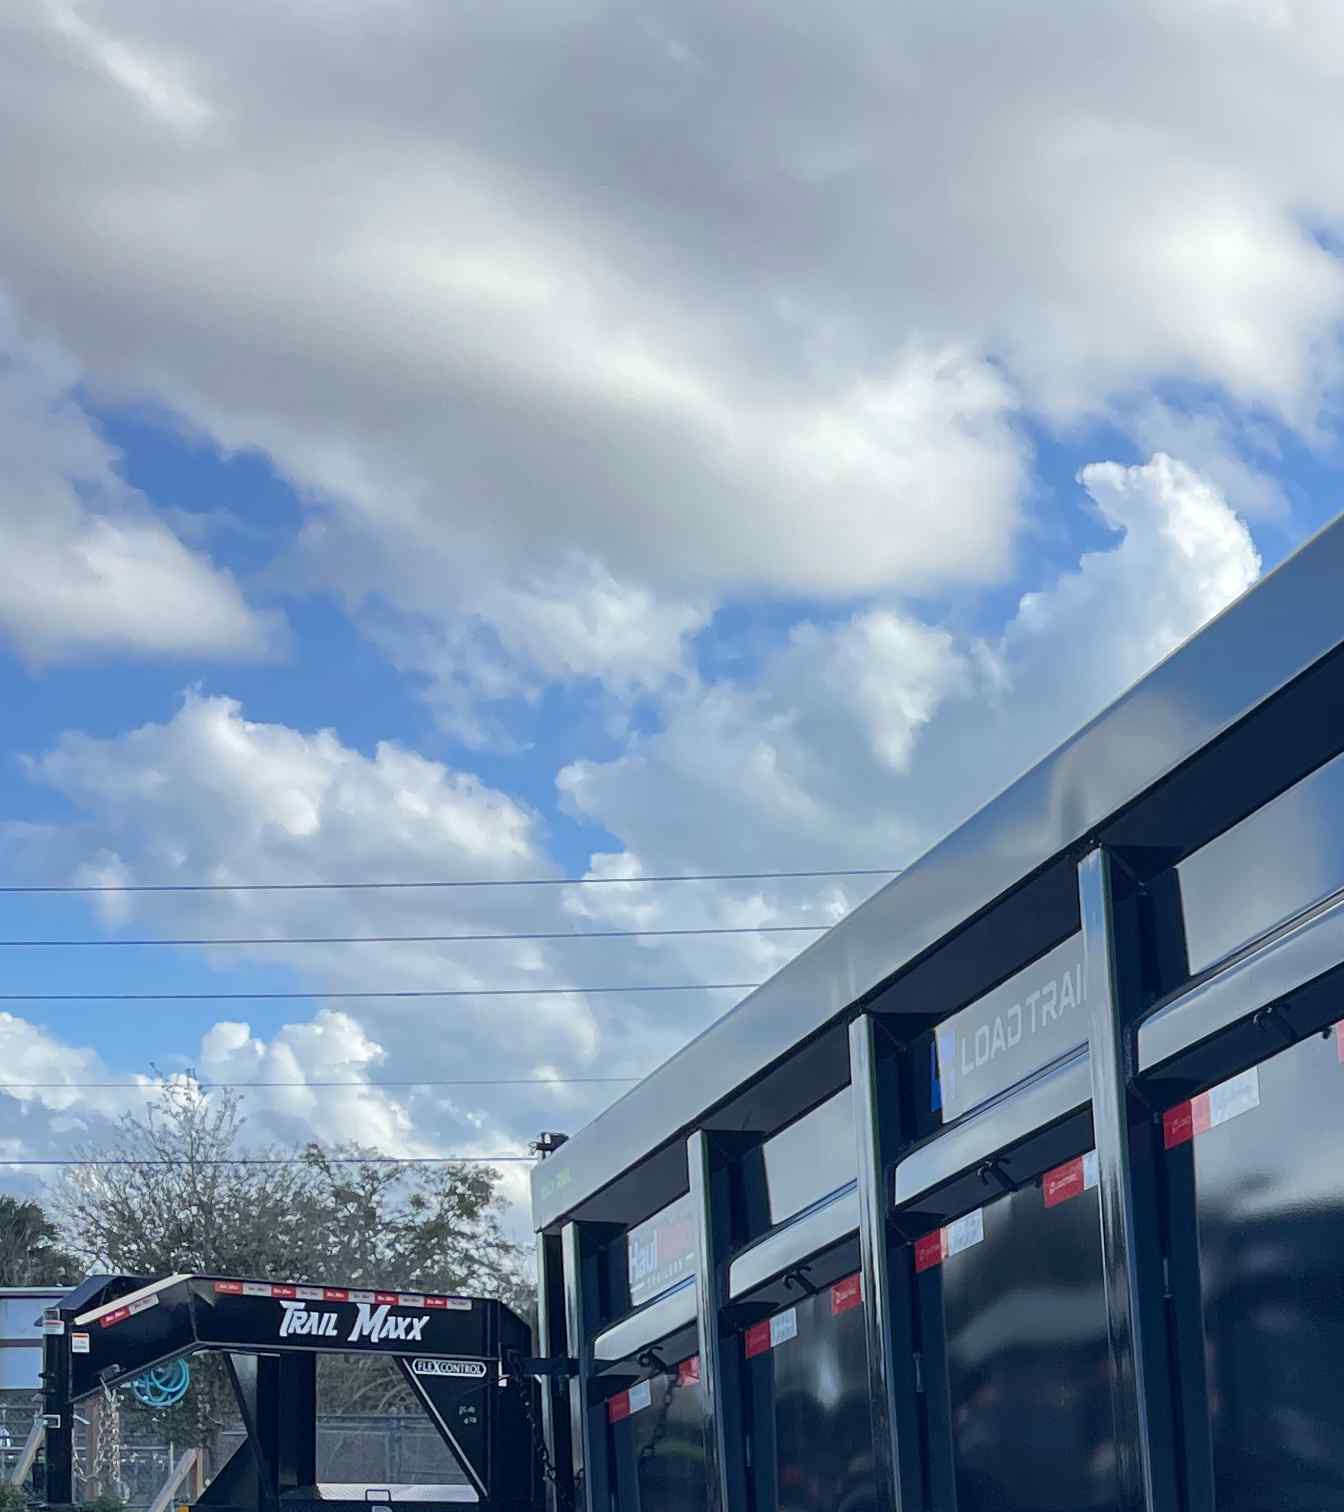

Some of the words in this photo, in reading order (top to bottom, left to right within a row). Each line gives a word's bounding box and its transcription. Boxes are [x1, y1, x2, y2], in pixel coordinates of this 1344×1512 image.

[961, 1003, 1022, 1076] LOAD
[1026, 963, 1081, 1033] TRAI
[279, 1300, 338, 1337] TRAIL
[347, 1302, 430, 1343] MAXX
